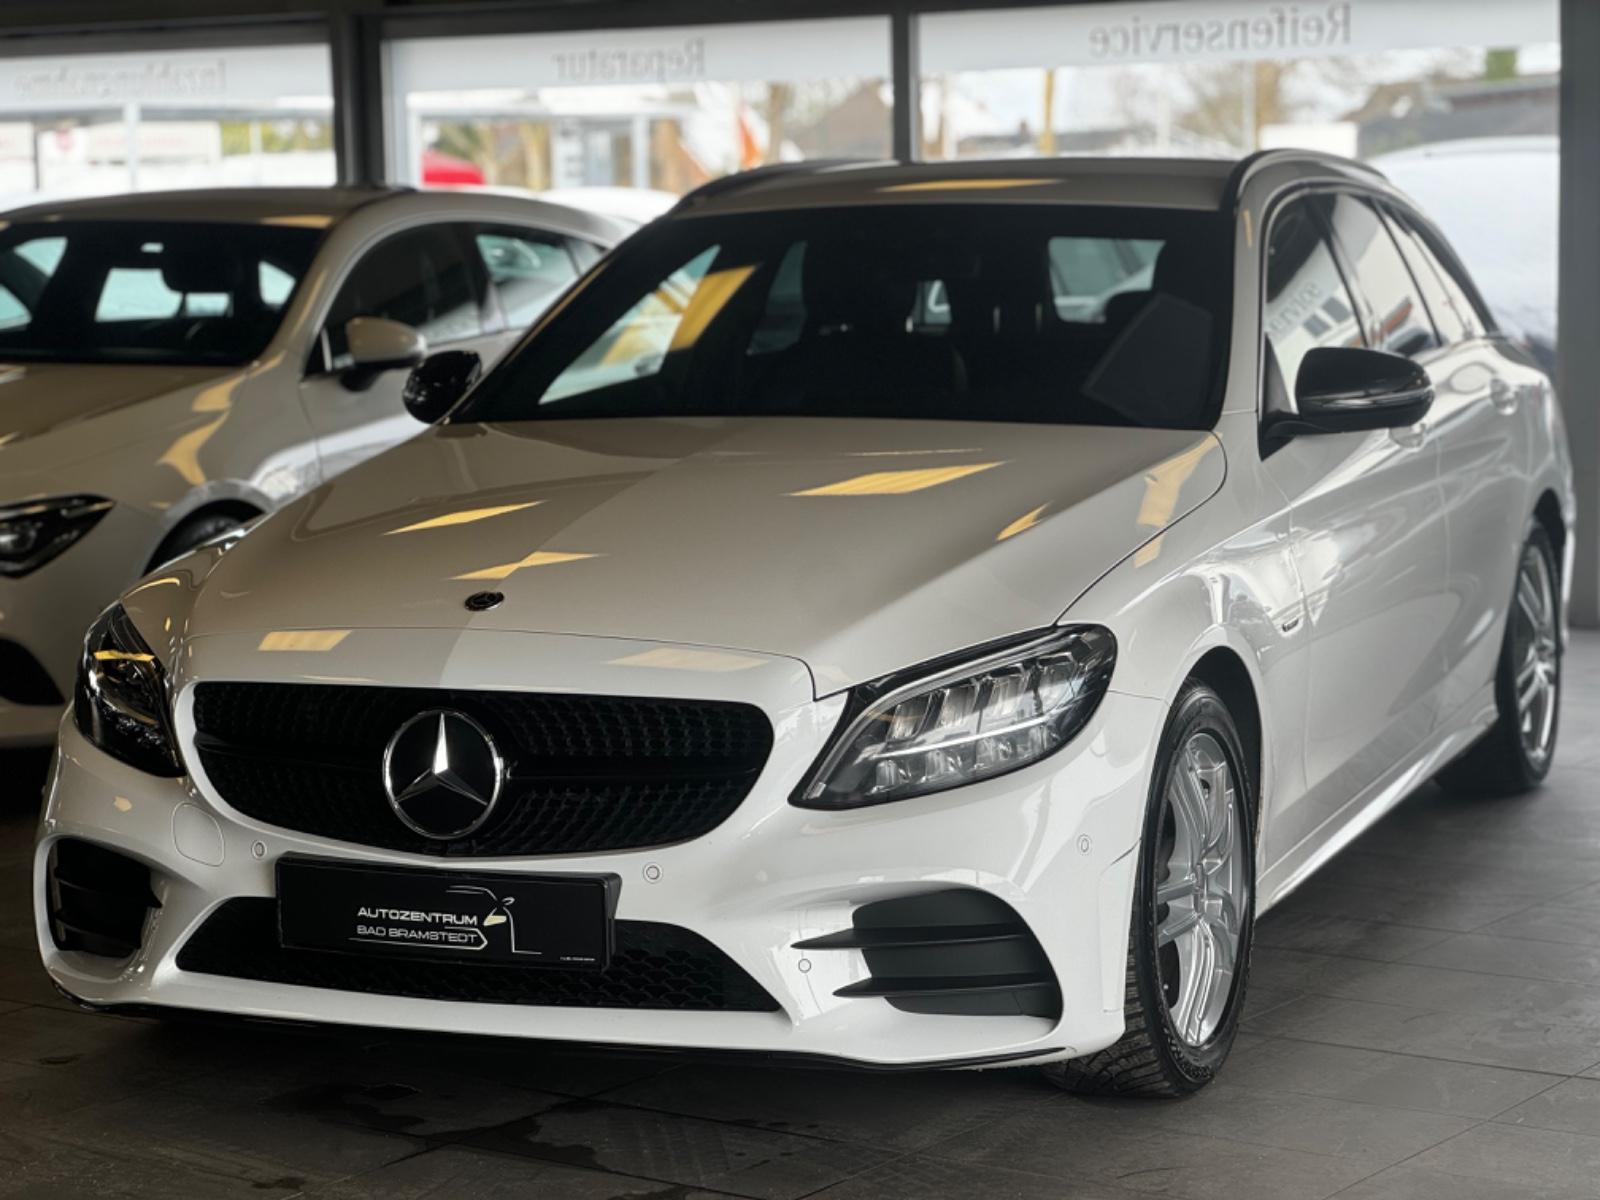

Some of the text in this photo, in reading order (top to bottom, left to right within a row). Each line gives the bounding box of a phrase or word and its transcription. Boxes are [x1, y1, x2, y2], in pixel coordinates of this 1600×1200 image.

[357, 906, 478, 926] AUTOZENTRUM
[357, 924, 478, 944] BAD BRAMSTEDT
